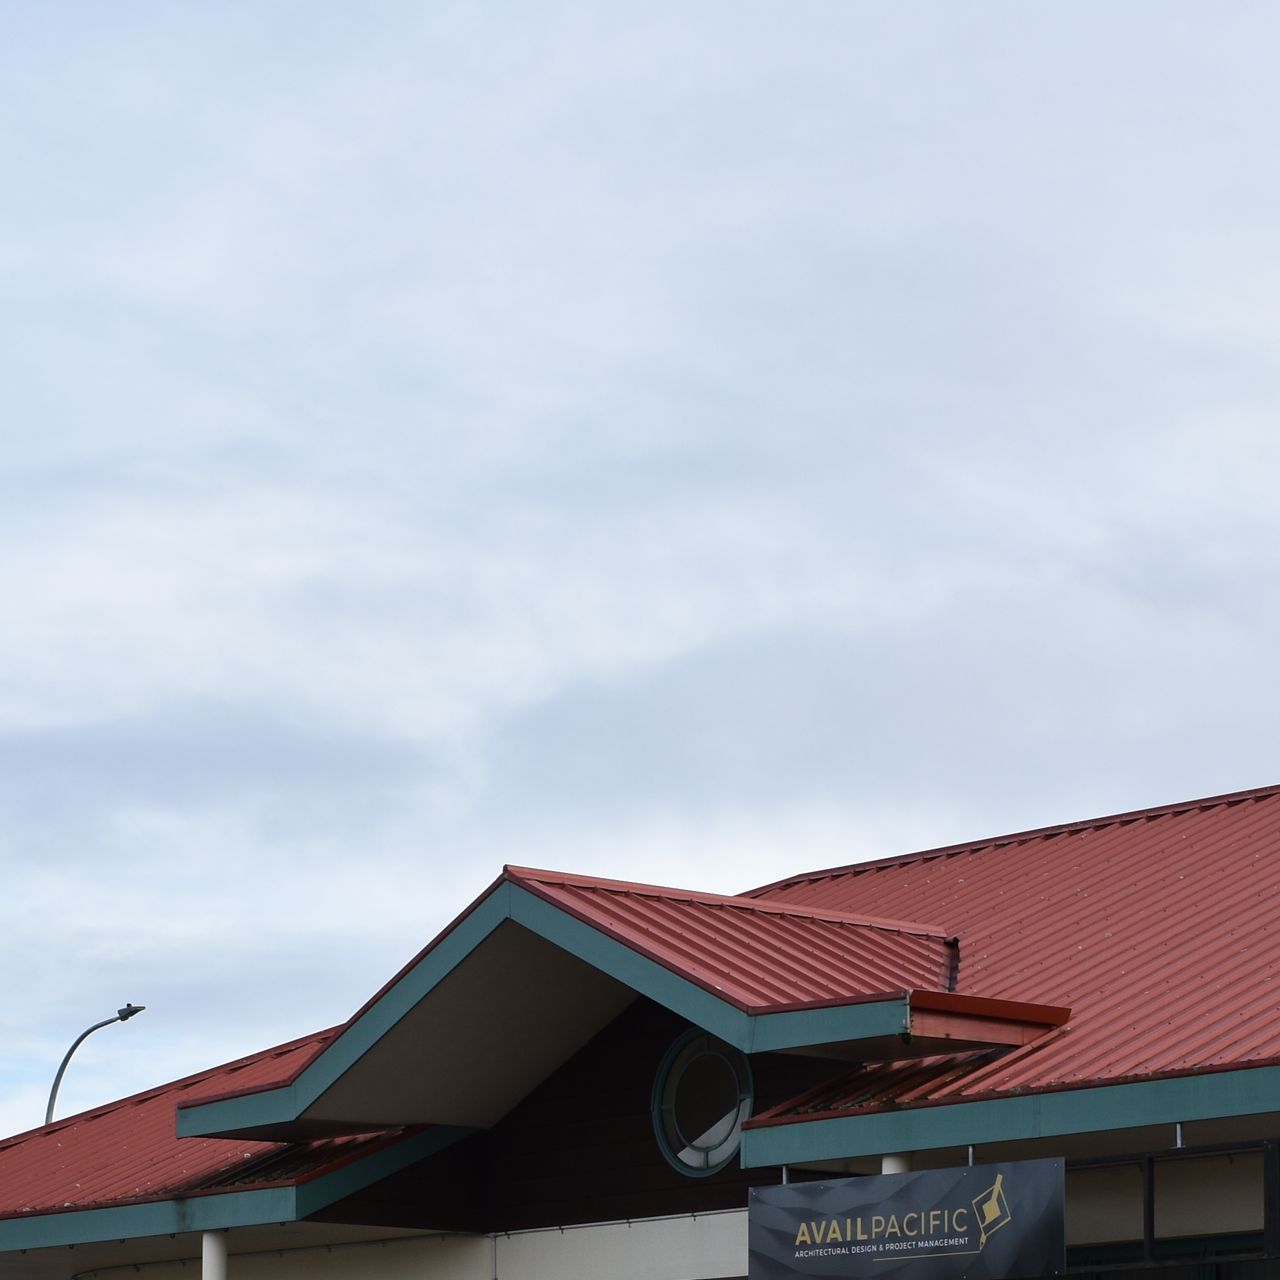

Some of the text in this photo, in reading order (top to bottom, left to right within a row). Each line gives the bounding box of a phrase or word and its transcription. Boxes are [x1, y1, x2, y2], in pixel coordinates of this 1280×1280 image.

[795, 1208, 968, 1246] AVAILPACIFIC
[794, 1237, 969, 1258] ARCHITECTURAL DESIGN & PROJECT MANAGEMENT
